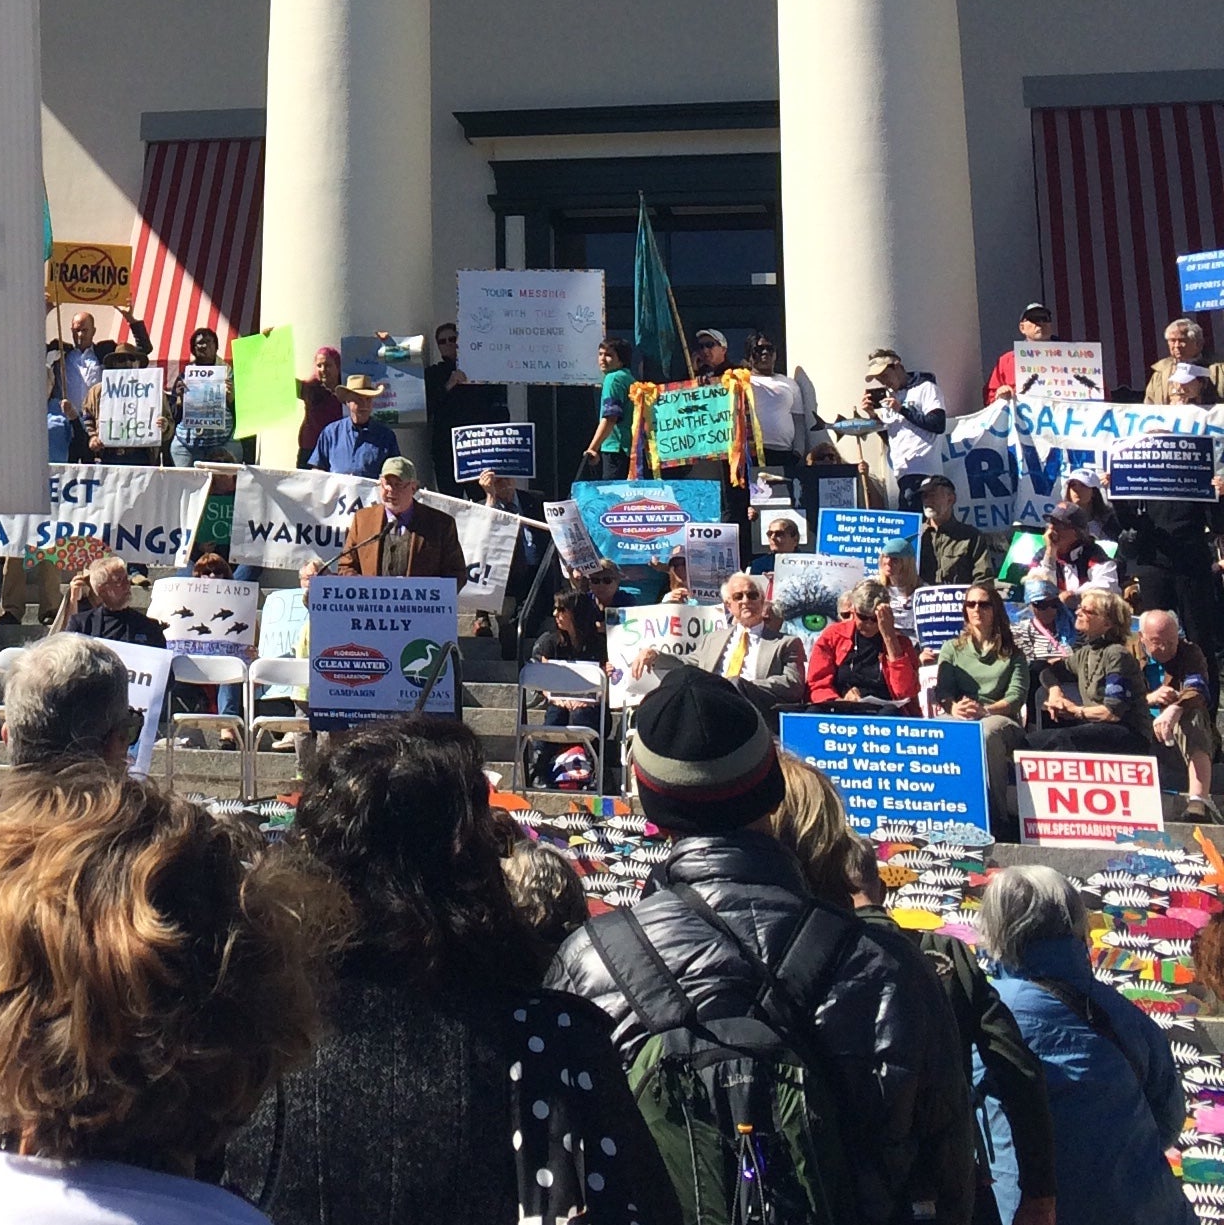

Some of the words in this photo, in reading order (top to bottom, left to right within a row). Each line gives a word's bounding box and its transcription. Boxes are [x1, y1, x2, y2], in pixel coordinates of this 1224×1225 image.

[1185, 280, 1221, 291] SUPPORTS
[509, 326, 565, 336] INNOCENCE
[470, 341, 483, 351] OF
[489, 343, 512, 352] OUR
[1020, 349, 1041, 357] BUY
[1045, 349, 1062, 357] THE
[1067, 349, 1094, 359] LAND
[188, 369, 214, 378] STOP
[1020, 365, 1047, 374] SEND
[1051, 366, 1068, 374] THE
[1071, 366, 1101, 375] CLEAN
[105, 377, 155, 398] Water
[1037, 378, 1073, 386] WATER
[657, 392, 680, 406] BUY
[682, 390, 701, 401] THE
[702, 387, 729, 400] LAND
[1047, 389, 1092, 398] SOUTH!
[107, 407, 155, 441] Life!
[185, 418, 224, 427] FRACKING!
[685, 414, 708, 428] THE
[465, 430, 485, 438] Vote
[487, 428, 504, 436] Yes
[505, 427, 520, 436] On
[456, 437, 523, 449] AMENDMENT
[526, 437, 531, 445] 1
[660, 435, 696, 454] SEND
[698, 434, 707, 443] IT
[1128, 440, 1153, 450] Vote
[1155, 439, 1176, 449] Yes
[1178, 439, 1196, 450] On
[1112, 450, 1202, 461] AMENDMENT
[1206, 453, 1211, 462] 1
[964, 445, 1108, 499] RIVE
[337, 494, 380, 516] SA
[206, 502, 234, 521] SIE
[605, 515, 643, 523] CLEAN
[645, 514, 685, 522] WATER
[836, 514, 857, 523] Stop
[860, 514, 876, 523] the
[877, 515, 904, 525] Harm
[212, 520, 232, 539] C
[689, 528, 722, 538] STOP
[838, 524, 856, 534] Buy
[858, 524, 874, 533] the
[876, 526, 901, 535] Land
[36, 520, 191, 557] SPRINGS!
[826, 534, 851, 542] Send
[852, 534, 881, 544] Water
[617, 541, 670, 551] CAMPAIGN
[839, 544, 863, 553] Fund
[781, 558, 799, 566] Cry
[866, 556, 879, 564] Es
[467, 562, 492, 586] G!
[187, 582, 209, 593] THE
[216, 584, 251, 596] LAND
[322, 587, 441, 601] FLORIDIANS
[330, 604, 354, 612] CLEAN
[357, 604, 384, 613] WATER
[386, 605, 392, 613] &
[394, 606, 445, 614] AMENDMENT
[448, 606, 453, 614] 1
[351, 618, 412, 632] RALLY
[622, 616, 683, 647] SAVE
[687, 616, 725, 639] OUR
[318, 661, 351, 669] CLEAN
[353, 661, 386, 670] WATER
[328, 688, 376, 697] CAMPAIGN
[399, 689, 451, 699] FLODA'S
[818, 722, 858, 737] Stop
[863, 723, 891, 737] the
[896, 725, 944, 738] Harm
[824, 739, 857, 755] Buy
[862, 741, 891, 754] the
[896, 742, 939, 756] Land
[805, 756, 848, 770] Send
[853, 758, 905, 773] Water
[909, 761, 961, 775] South
[1021, 759, 1151, 784] PIPELINE?
[830, 776, 872, 790] Fund
[878, 777, 891, 791] it
[896, 778, 935, 792] Now
[849, 795, 878, 808] the
[883, 796, 968, 813] Estuaries
[1047, 787, 1132, 816] NO!
